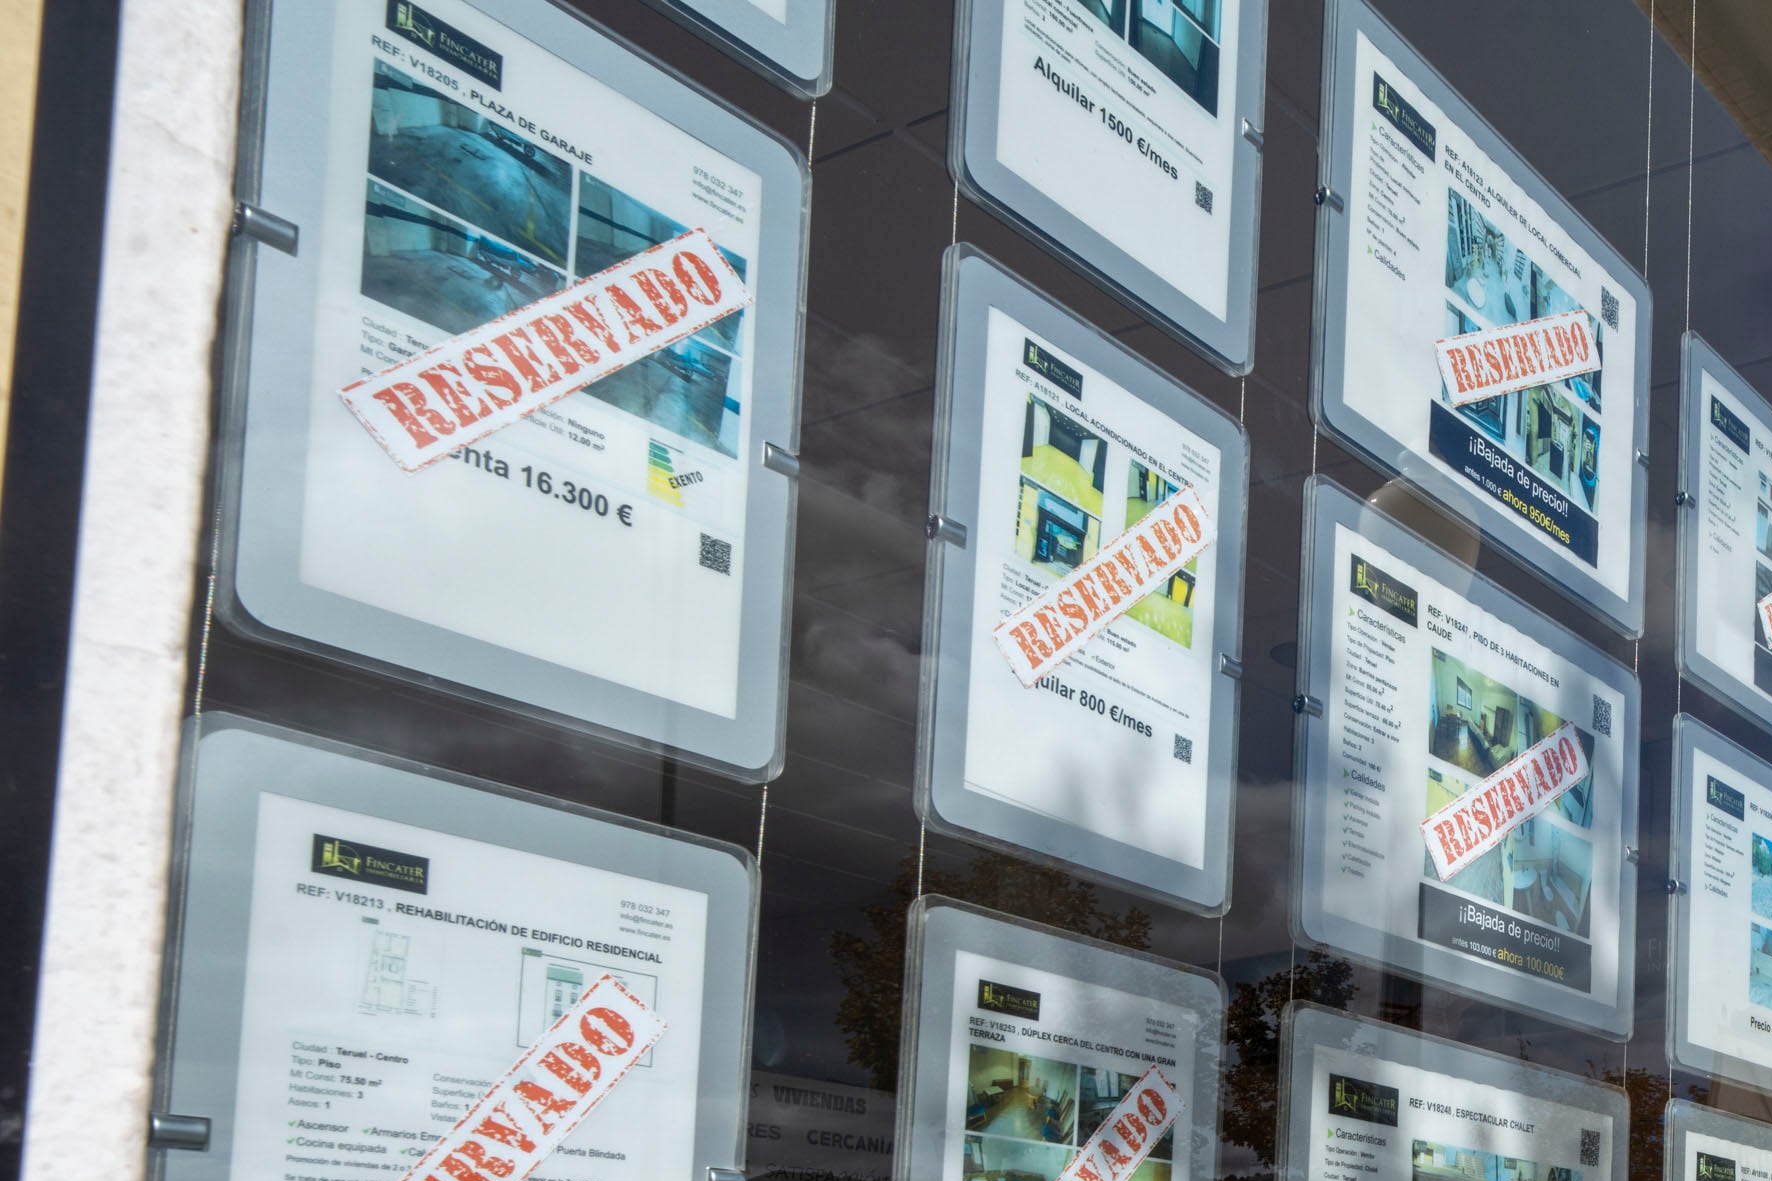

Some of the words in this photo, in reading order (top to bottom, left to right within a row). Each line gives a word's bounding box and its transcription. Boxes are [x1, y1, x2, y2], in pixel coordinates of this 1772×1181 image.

[372, 35, 404, 62] REF:
[410, 56, 458, 91] V18205
[470, 90, 515, 123] PLAZA
[518, 116, 536, 135] DE
[540, 129, 593, 165] GARAJE
[1034, 56, 1095, 113] Alquilar
[1100, 108, 1133, 144] 1500
[1137, 138, 1178, 180] €/mes
[1444, 160, 1454, 175] EN
[1455, 170, 1463, 183] EL
[1465, 179, 1491, 208] CENTRO
[373, 251, 722, 449] RESERVADO
[1446, 321, 1589, 393] RESERVADO
[450, 446, 509, 479] enta
[521, 465, 608, 517] 16.300
[617, 504, 632, 527] €
[669, 471, 704, 489] EXENTO
[1517, 470, 1530, 489] de
[1532, 482, 1569, 517] precio!!
[1503, 488, 1528, 515] ahora
[1529, 507, 1571, 544] 950€/mes
[1008, 504, 1201, 670] RESERVADO
[1381, 583, 1416, 610] FINCATER
[1357, 609, 1406, 644] Características
[1427, 621, 1452, 641] CAUDE
[1079, 690, 1105, 715] 800
[1109, 706, 1153, 737] €/mes
[1351, 770, 1386, 792] Calidades
[1433, 737, 1578, 865] RESERVADO
[365, 855, 424, 878] FINCATER
[296, 883, 330, 899] REF:
[335, 890, 384, 910] V18213
[395, 902, 507, 933] REHABILITACIÓN
[511, 924, 528, 937] DE
[531, 930, 583, 949] EDIFICIO
[586, 941, 663, 964] RESIDENCIAL
[620, 900, 636, 910] 978
[638, 903, 653, 914] 032
[654, 906, 670, 917] 347
[1508, 921, 1522, 938] de
[1524, 926, 1560, 953] precio!!
[1498, 948, 1523, 966] ahora
[1526, 956, 1565, 980] 100.000€
[969, 1028, 1006, 1043] TERRAZA
[1750, 1016, 1771, 1033] Precio
[773, 1085, 866, 1115] VIVIENDAS
[296, 1136, 335, 1149] Cocina
[338, 1140, 388, 1155] equipada
[297, 1120, 349, 1134] Ascensor
[372, 1126, 418, 1140] Armarios
[1335, 1128, 1386, 1146] Características
[557, 1145, 585, 1157] Puerta
[588, 1149, 626, 1161] Blindada
